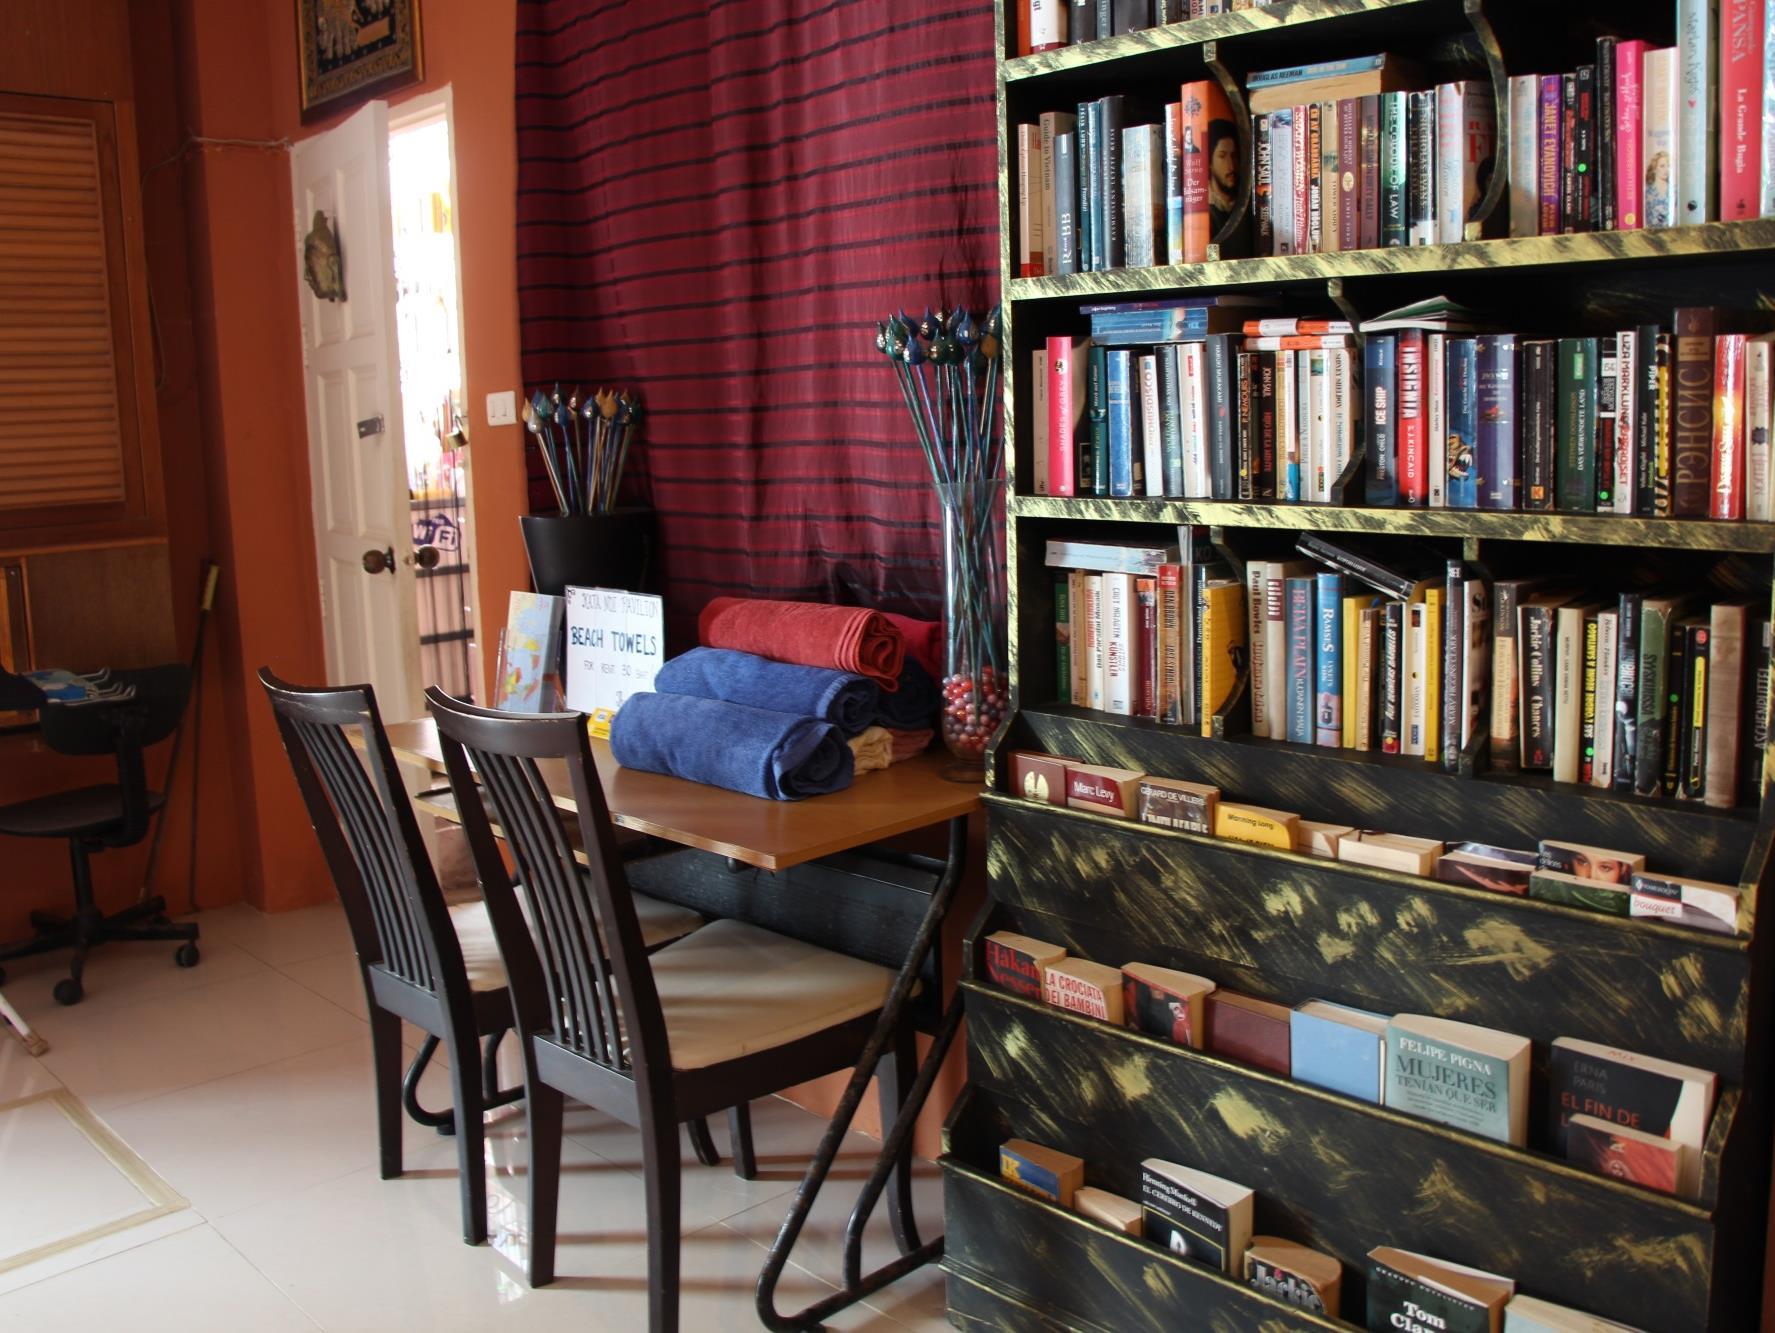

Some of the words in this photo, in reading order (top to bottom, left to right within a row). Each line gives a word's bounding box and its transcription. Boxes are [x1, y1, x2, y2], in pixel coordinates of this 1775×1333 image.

[1736, 88, 1748, 102] La
[1043, 119, 1052, 143] Guide
[1545, 103, 1557, 135] JANET
[1736, 105, 1748, 141] Grande
[1043, 145, 1052, 155] to
[1257, 141, 1271, 164] JOHN
[1735, 144, 1748, 174] Bugia
[1043, 156, 1052, 190] Vietnam
[1257, 166, 1271, 186] SAUL
[1544, 138, 1557, 196] EVANOVICH
[1310, 185, 1319, 208] JOHAN
[1390, 179, 1399, 190] OF
[1390, 194, 1399, 218] LAW
[1215, 344, 1223, 368] HARUKI
[1621, 333, 1631, 359] LIZA
[1263, 367, 1272, 382] JOHN
[1335, 353, 1343, 377] SIDNEY
[1215, 369, 1224, 403] MURAKAMI
[1263, 383, 1272, 398] SAUL
[1335, 378, 1343, 408] SHELDON
[1401, 346, 1420, 418] INSIGNIA
[1374, 386, 1386, 408] SHIP
[1577, 388, 1586, 408] LAND
[1374, 409, 1386, 425] ICE
[1577, 457, 1585, 472] DAS
[439, 529, 456, 546] Fi
[1112, 587, 1120, 603] CODY
[1252, 570, 1263, 596] Paul
[1094, 590, 1102, 620] Mosaik
[1165, 590, 1175, 604] DAN
[1165, 605, 1175, 629] BROWN
[1252, 597, 1263, 635] Bowles
[1293, 588, 1307, 633] BELVA
[570, 625, 604, 648] BEACH
[610, 630, 657, 656] TOWELS
[1530, 616, 1543, 650] Jackie
[1588, 623, 1597, 660] SANTIAGO
[1293, 636, 1307, 679] PLAIN
[1448, 634, 1457, 662] CLARK
[1448, 664, 1457, 697] HIGGINS
[1530, 651, 1543, 687] Collins
[1448, 700, 1457, 726] MARY
[1530, 695, 1543, 738] Chances
[1585, 692, 1595, 722] L'ORDRE
[1584, 724, 1594, 738] SAS
[1073, 780, 1095, 796] Marc
[1095, 785, 1115, 802] Levy
[1167, 791, 1179, 802] DE
[1634, 896, 1676, 915] bouquet
[1045, 972, 1057, 986] LA
[1064, 993, 1106, 1019] BAMBINI
[1400, 1036, 1447, 1062] FELIPE
[1450, 1052, 1492, 1077] PIGNA
[1397, 1053, 1497, 1100] MUJERES
[1573, 1061, 1609, 1080] ERNA
[1573, 1075, 1607, 1095] PARIS
[1445, 1087, 1472, 1105] QUE
[1473, 1096, 1497, 1114] SER
[1560, 1091, 1580, 1111] EL
[1584, 1098, 1614, 1120] FIN
[1616, 1108, 1641, 1128] DE
[1142, 1171, 1171, 1195] Henning
[1142, 1184, 1152, 1195] EL
[1402, 1300, 1447, 1330] Tom
